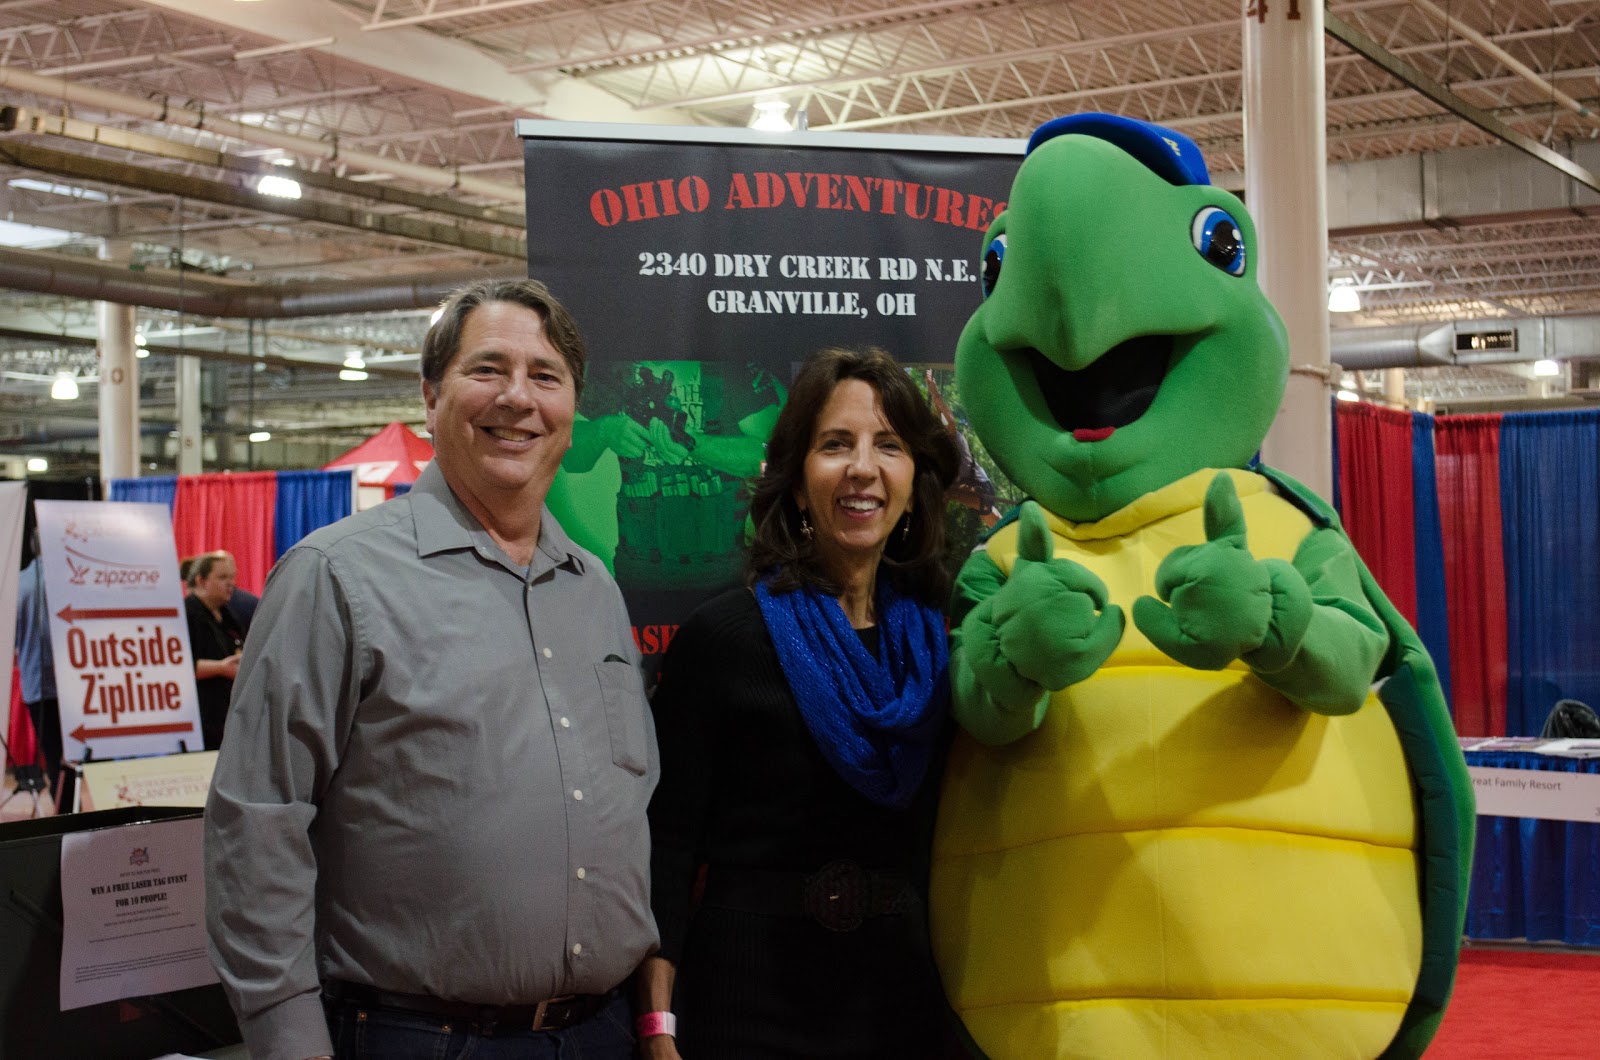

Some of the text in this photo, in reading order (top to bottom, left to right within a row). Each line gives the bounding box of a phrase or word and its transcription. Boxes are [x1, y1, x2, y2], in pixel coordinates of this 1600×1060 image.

[590, 175, 710, 227] OHIO
[638, 252, 977, 282] 2340 DRY CREEK RD N.E.
[707, 289, 917, 319] GRANVILLE, OH
[94, 568, 160, 587] zipzone
[66, 624, 184, 670] Outside
[80, 671, 182, 724] Zipline
[1472, 778, 1561, 791] reat Family Resort
[90, 874, 188, 895] WIN A FREE LASER TAG EVENT
[115, 892, 168, 908] FOR 10 PEOPLE!
